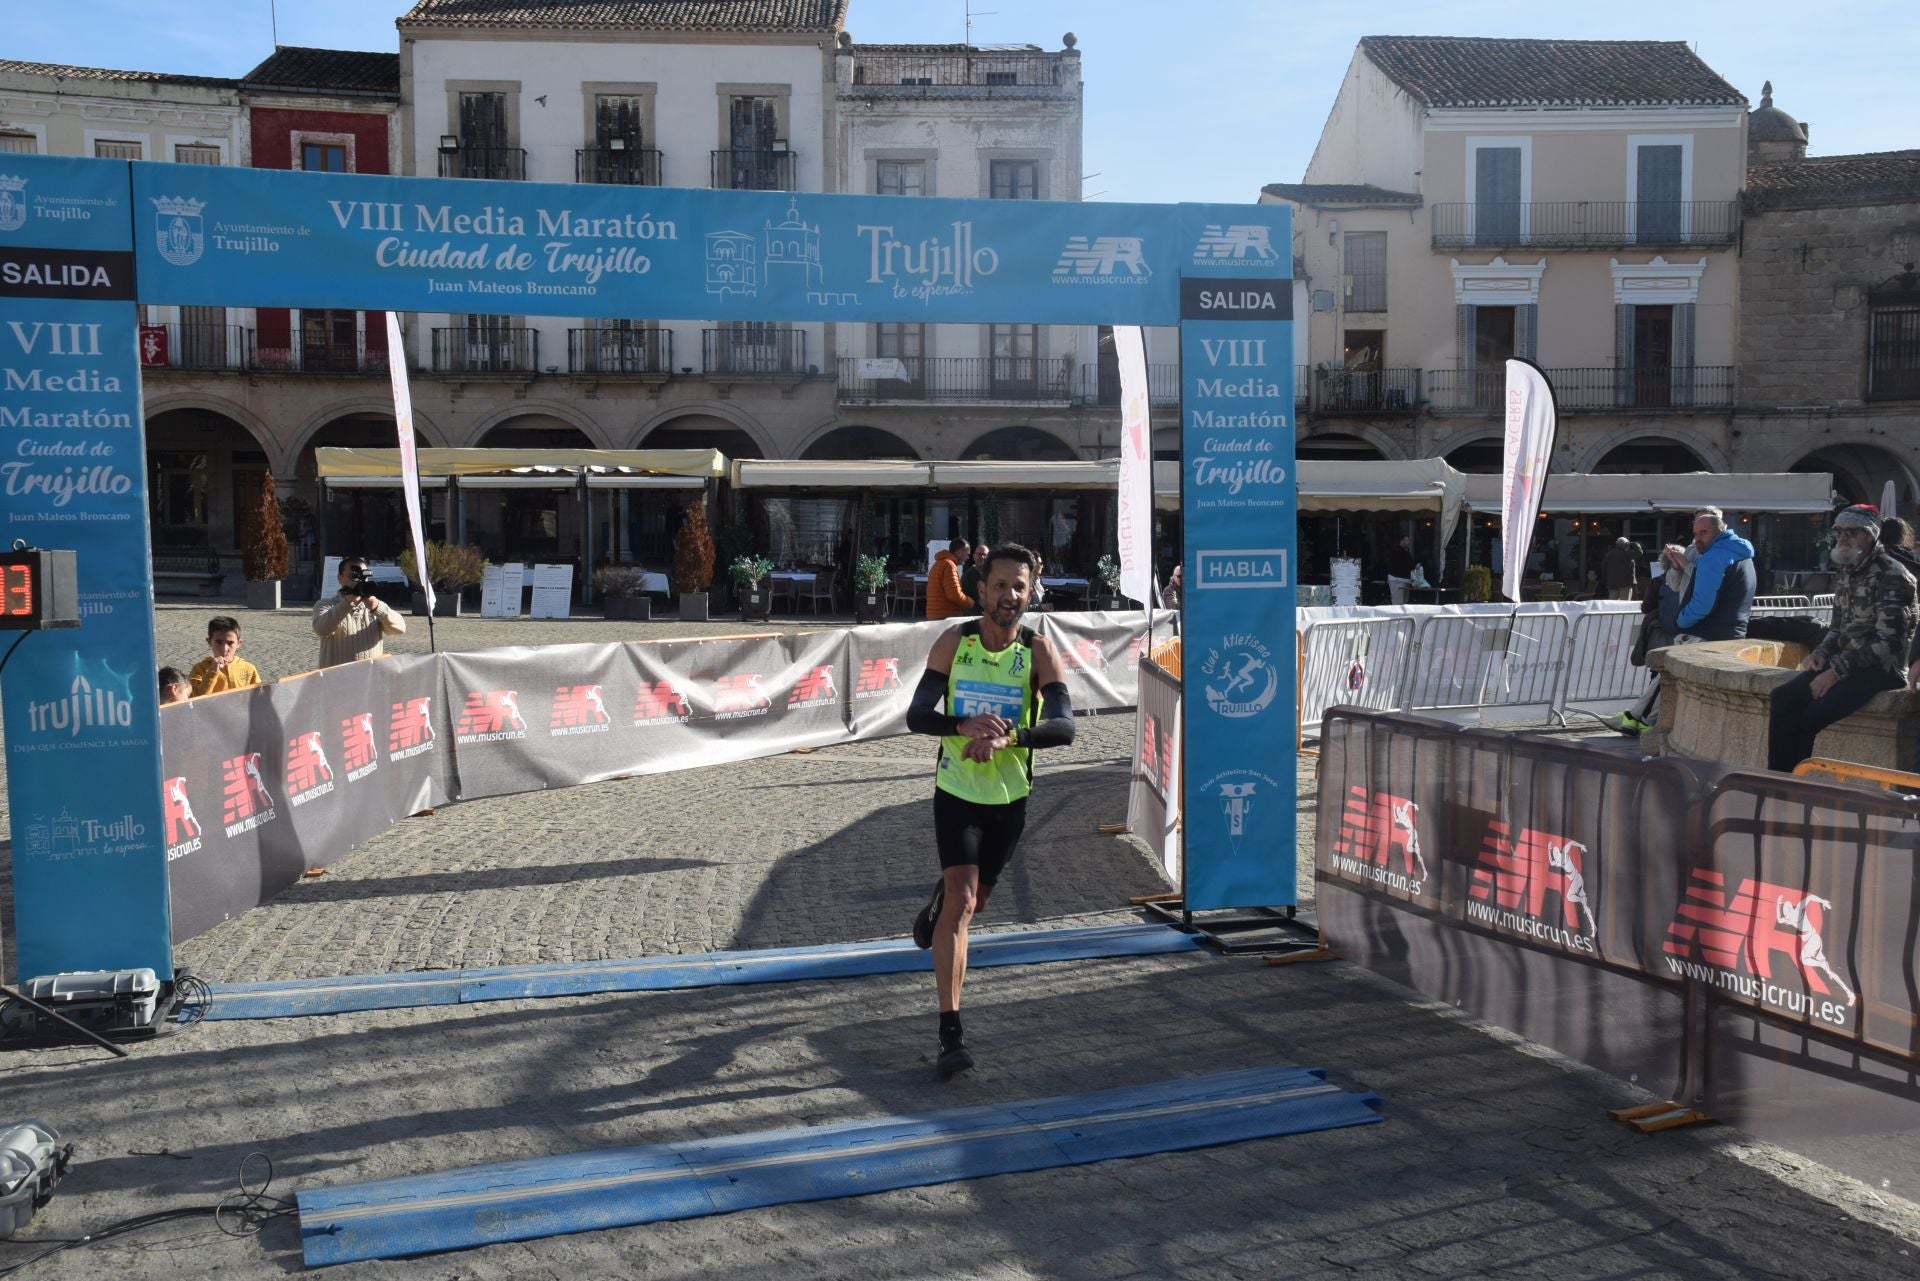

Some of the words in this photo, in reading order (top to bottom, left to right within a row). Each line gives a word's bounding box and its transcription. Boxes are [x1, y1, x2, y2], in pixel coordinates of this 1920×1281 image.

[34, 194, 104, 206] Ayuntamiento
[105, 197, 118, 207] de
[33, 206, 91, 221] Trujillo
[328, 200, 404, 231] VIII
[415, 203, 526, 236] Media
[536, 209, 678, 240] Maratón
[213, 222, 295, 235] Ayuntamiento
[297, 225, 311, 236] de
[212, 235, 280, 255] Trujillo
[857, 221, 998, 287] Trujillo
[376, 237, 490, 269] Ciudad
[495, 243, 536, 271] de
[543, 242, 650, 284] Trujillo
[1192, 257, 1275, 267] www.musicrun.es
[2, 262, 111, 287] SALIDA
[1051, 273, 1149, 285] www.musicrun.es
[428, 278, 464, 294] Juan
[468, 279, 522, 294] Mateos
[527, 281, 597, 296] Broncano
[893, 277, 907, 298] te
[1200, 291, 1276, 310] SALIDA
[7, 321, 103, 355] VIII
[1200, 339, 1267, 366] VIII
[4, 367, 122, 392] Media
[1196, 378, 1280, 398] Media
[0, 406, 133, 428] Maratón
[1192, 410, 1287, 428] Maratón
[17, 438, 88, 457] Ciudad
[90, 440, 114, 456] de
[1203, 437, 1252, 453] Ciudad
[1255, 438, 1274, 453] de
[0, 461, 132, 507] Trujillo
[1192, 457, 1286, 495] Trujillo
[1197, 499, 1216, 509] Juan
[1218, 499, 1246, 507] Mateos
[1247, 499, 1285, 507] Broncano
[9, 512, 35, 523] Juan
[38, 512, 77, 521] Mateos
[79, 511, 131, 521] Broncano
[1210, 561, 1274, 577] HABLA
[128, 589, 140, 599] de
[1201, 647, 1219, 674] Club
[1223, 632, 1271, 658] Atletismo
[29, 675, 133, 737] trujillo
[787, 697, 836, 710] www.musicrun.es
[1212, 699, 1262, 713] TRUJILLO
[634, 714, 689, 727] www.musicrun.es
[715, 707, 768, 721] www.musicrun.es
[458, 731, 526, 744] www.musicrun.es
[550, 723, 609, 736] www.musicrun.es
[121, 738, 149, 747] MAGIA
[291, 781, 334, 807] www.musicrun.es
[81, 814, 145, 842] Trujillo
[225, 807, 276, 839] www.musicrun.es
[1332, 853, 1422, 895] www.musicrun.es
[1467, 900, 1593, 953] www.musicrun.es
[1665, 955, 1846, 1025] www.musicrun.es
